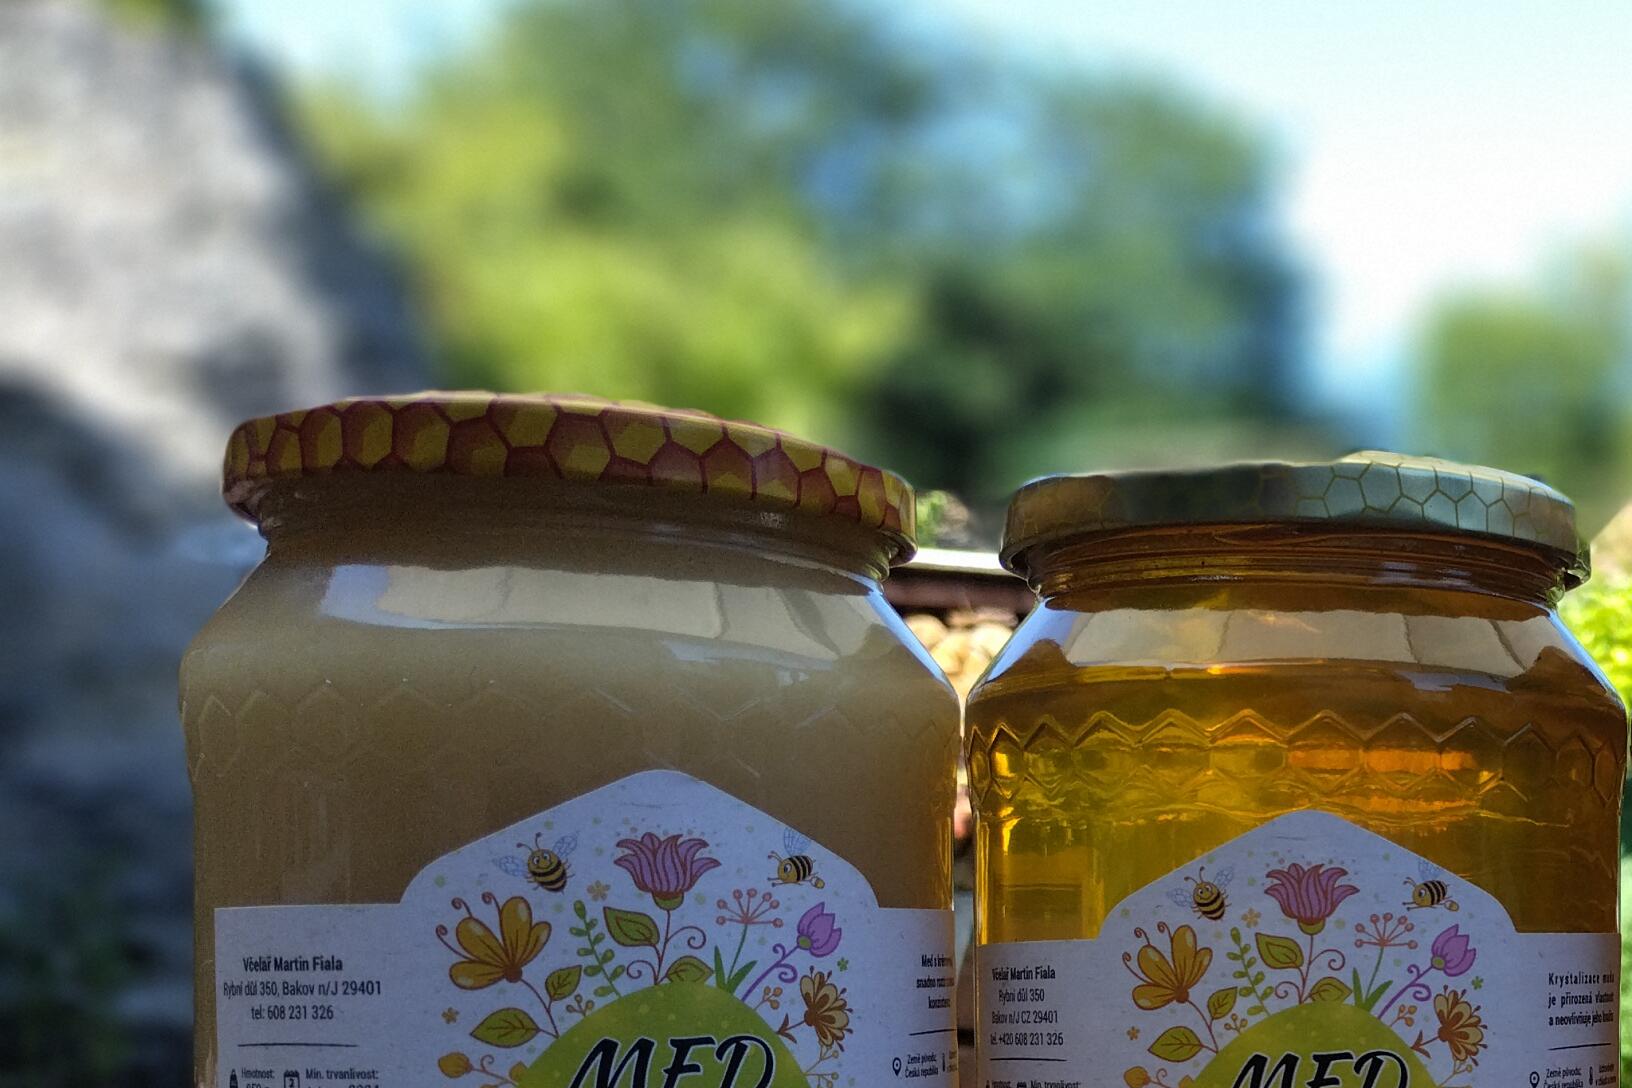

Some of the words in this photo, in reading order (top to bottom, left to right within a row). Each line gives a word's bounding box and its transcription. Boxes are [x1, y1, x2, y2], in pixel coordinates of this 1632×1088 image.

[274, 956, 309, 972] Martin
[313, 955, 343, 971] Fiala
[1010, 966, 1033, 980] Martin
[1035, 965, 1056, 980] Fiala
[1548, 971, 1600, 988] Krystalizace
[282, 981, 314, 996] Bakov
[318, 981, 338, 996] n/J
[342, 980, 381, 996] 29401
[1029, 989, 1045, 1002] 350
[1548, 992, 1556, 1009] je
[267, 1005, 286, 1020] 608
[288, 1005, 307, 1020] 231
[312, 1005, 334, 1020] 326
[1021, 1011, 1031, 1024] CZ
[1033, 1010, 1058, 1024] 29401
[1549, 1016, 1554, 1026] a
[1015, 1032, 1028, 1046] 608
[1030, 1032, 1043, 1046] 231
[1046, 1032, 1064, 1046] 326
